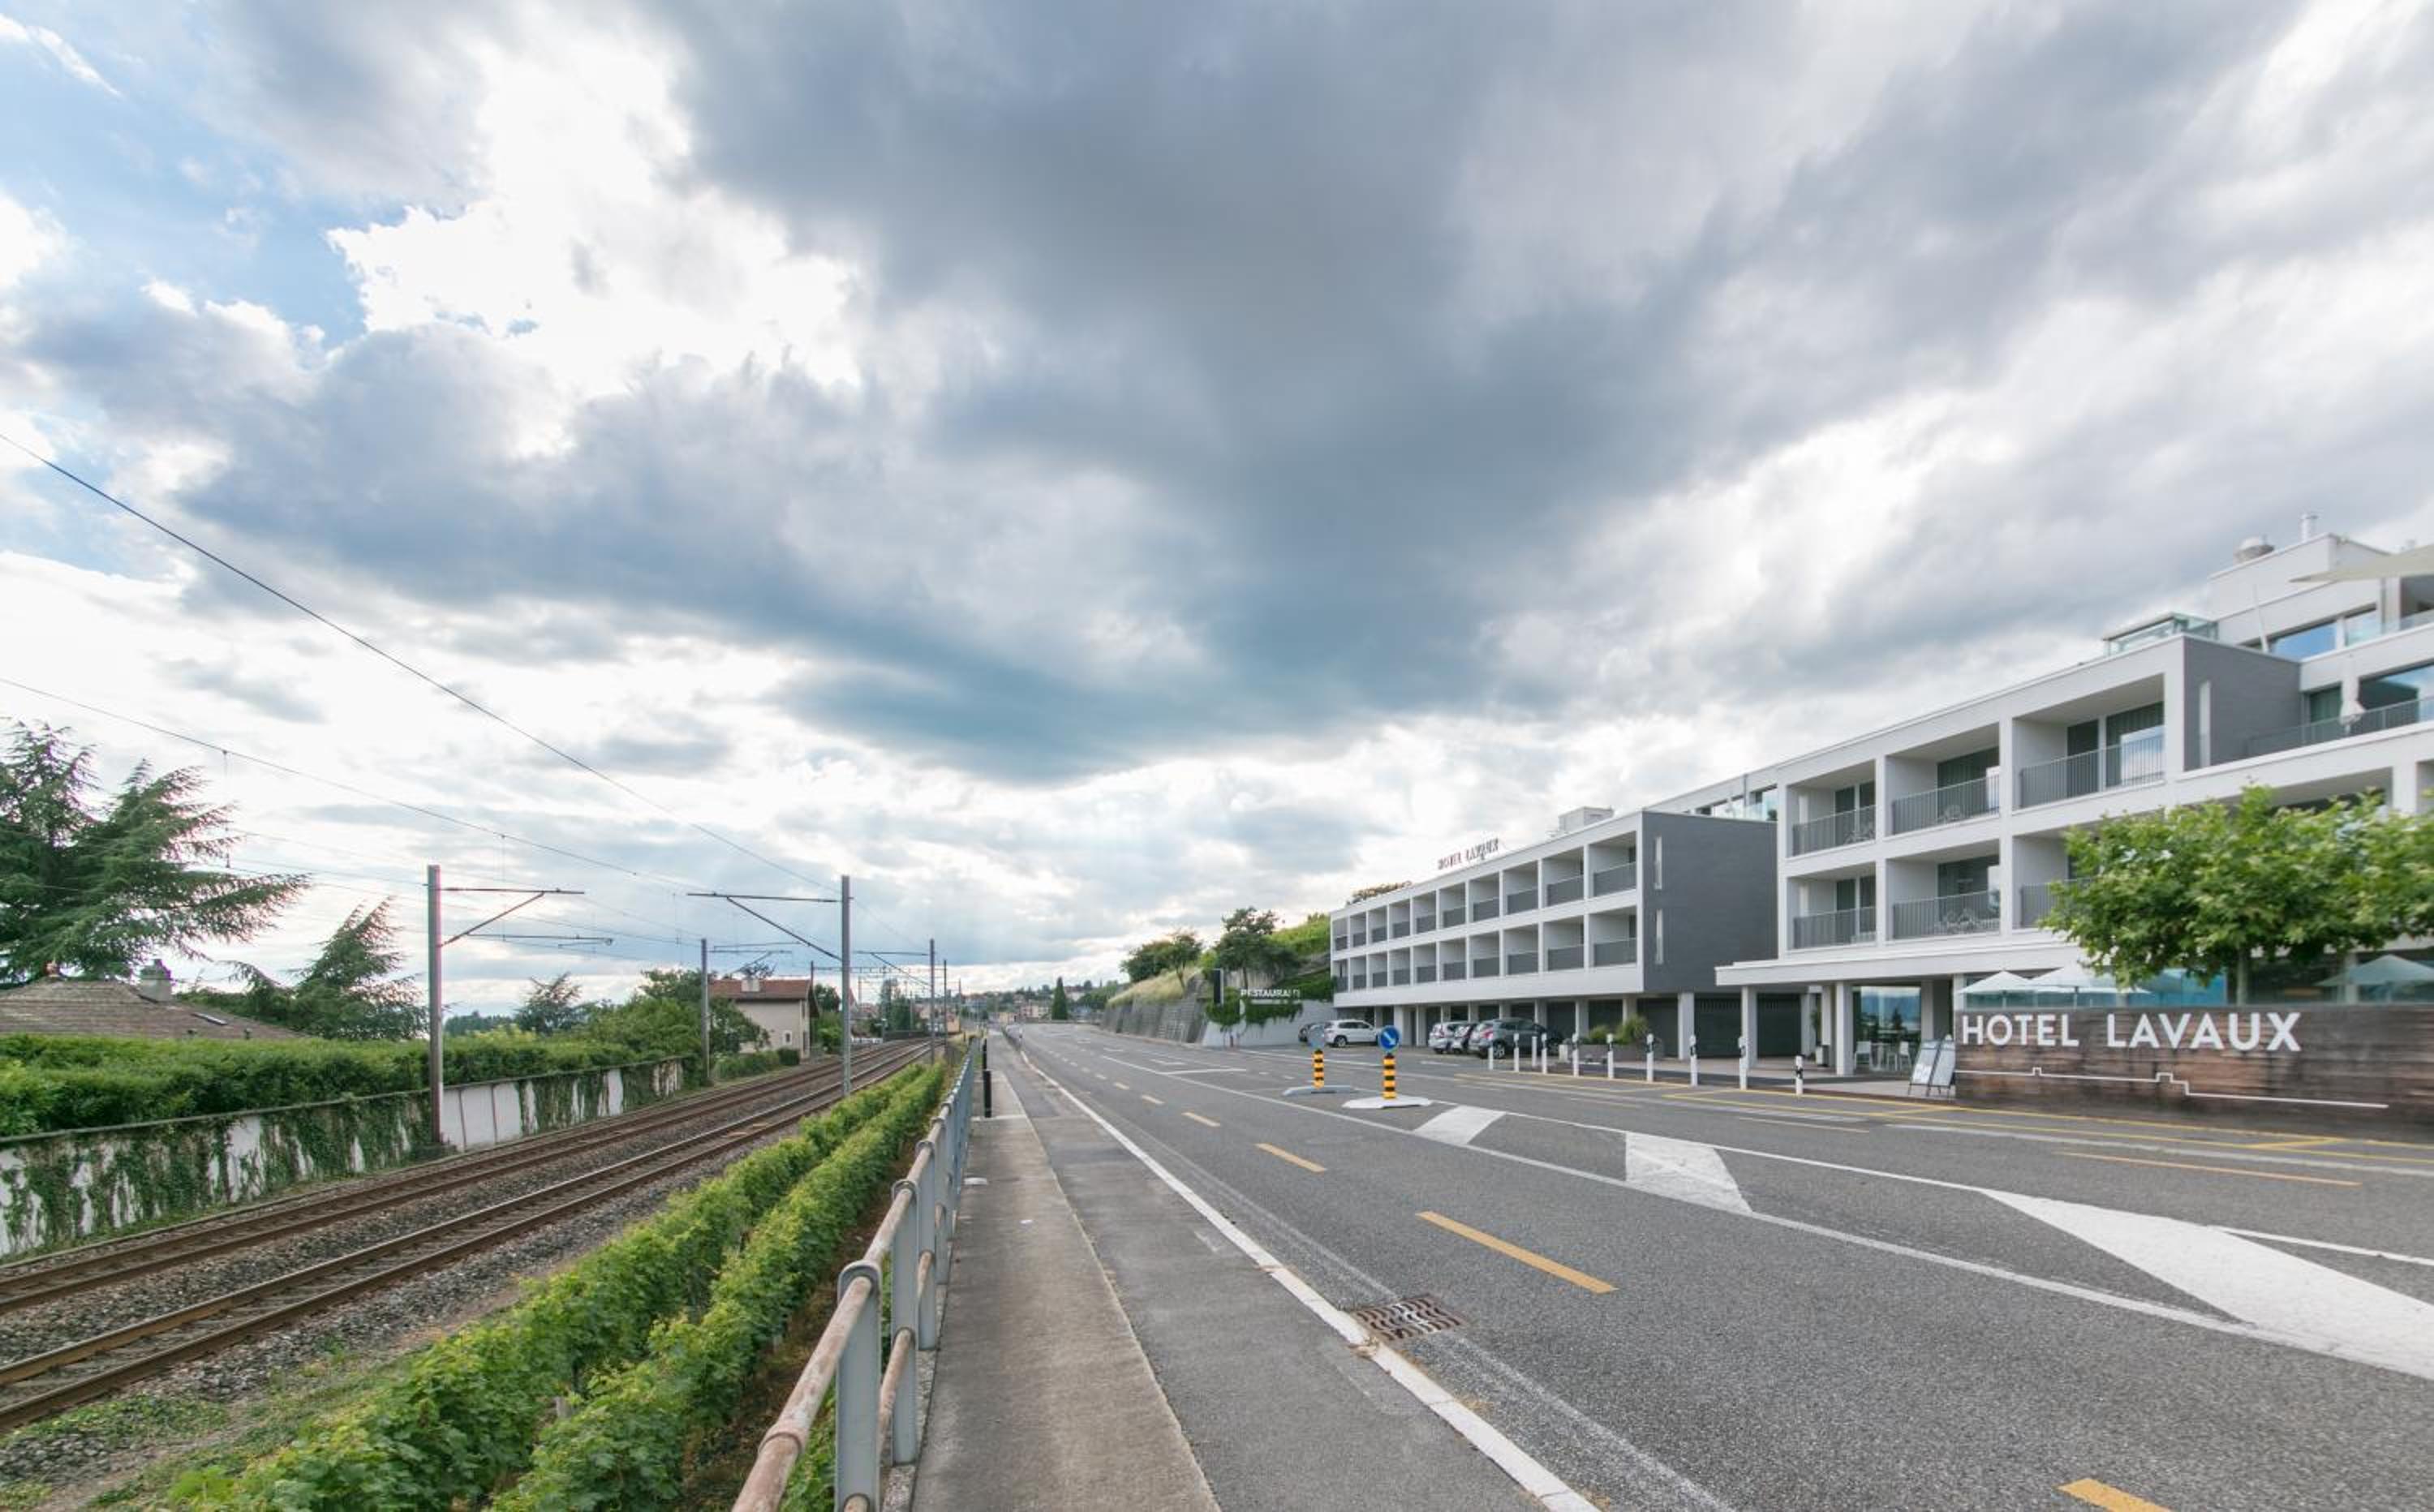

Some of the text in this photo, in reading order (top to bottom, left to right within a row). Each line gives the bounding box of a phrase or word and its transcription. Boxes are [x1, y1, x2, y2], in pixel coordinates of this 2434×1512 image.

[1437, 838, 1499, 870] HOTEL LAVAUX
[1962, 1012, 2302, 1052] HOTEL LAVAUX
